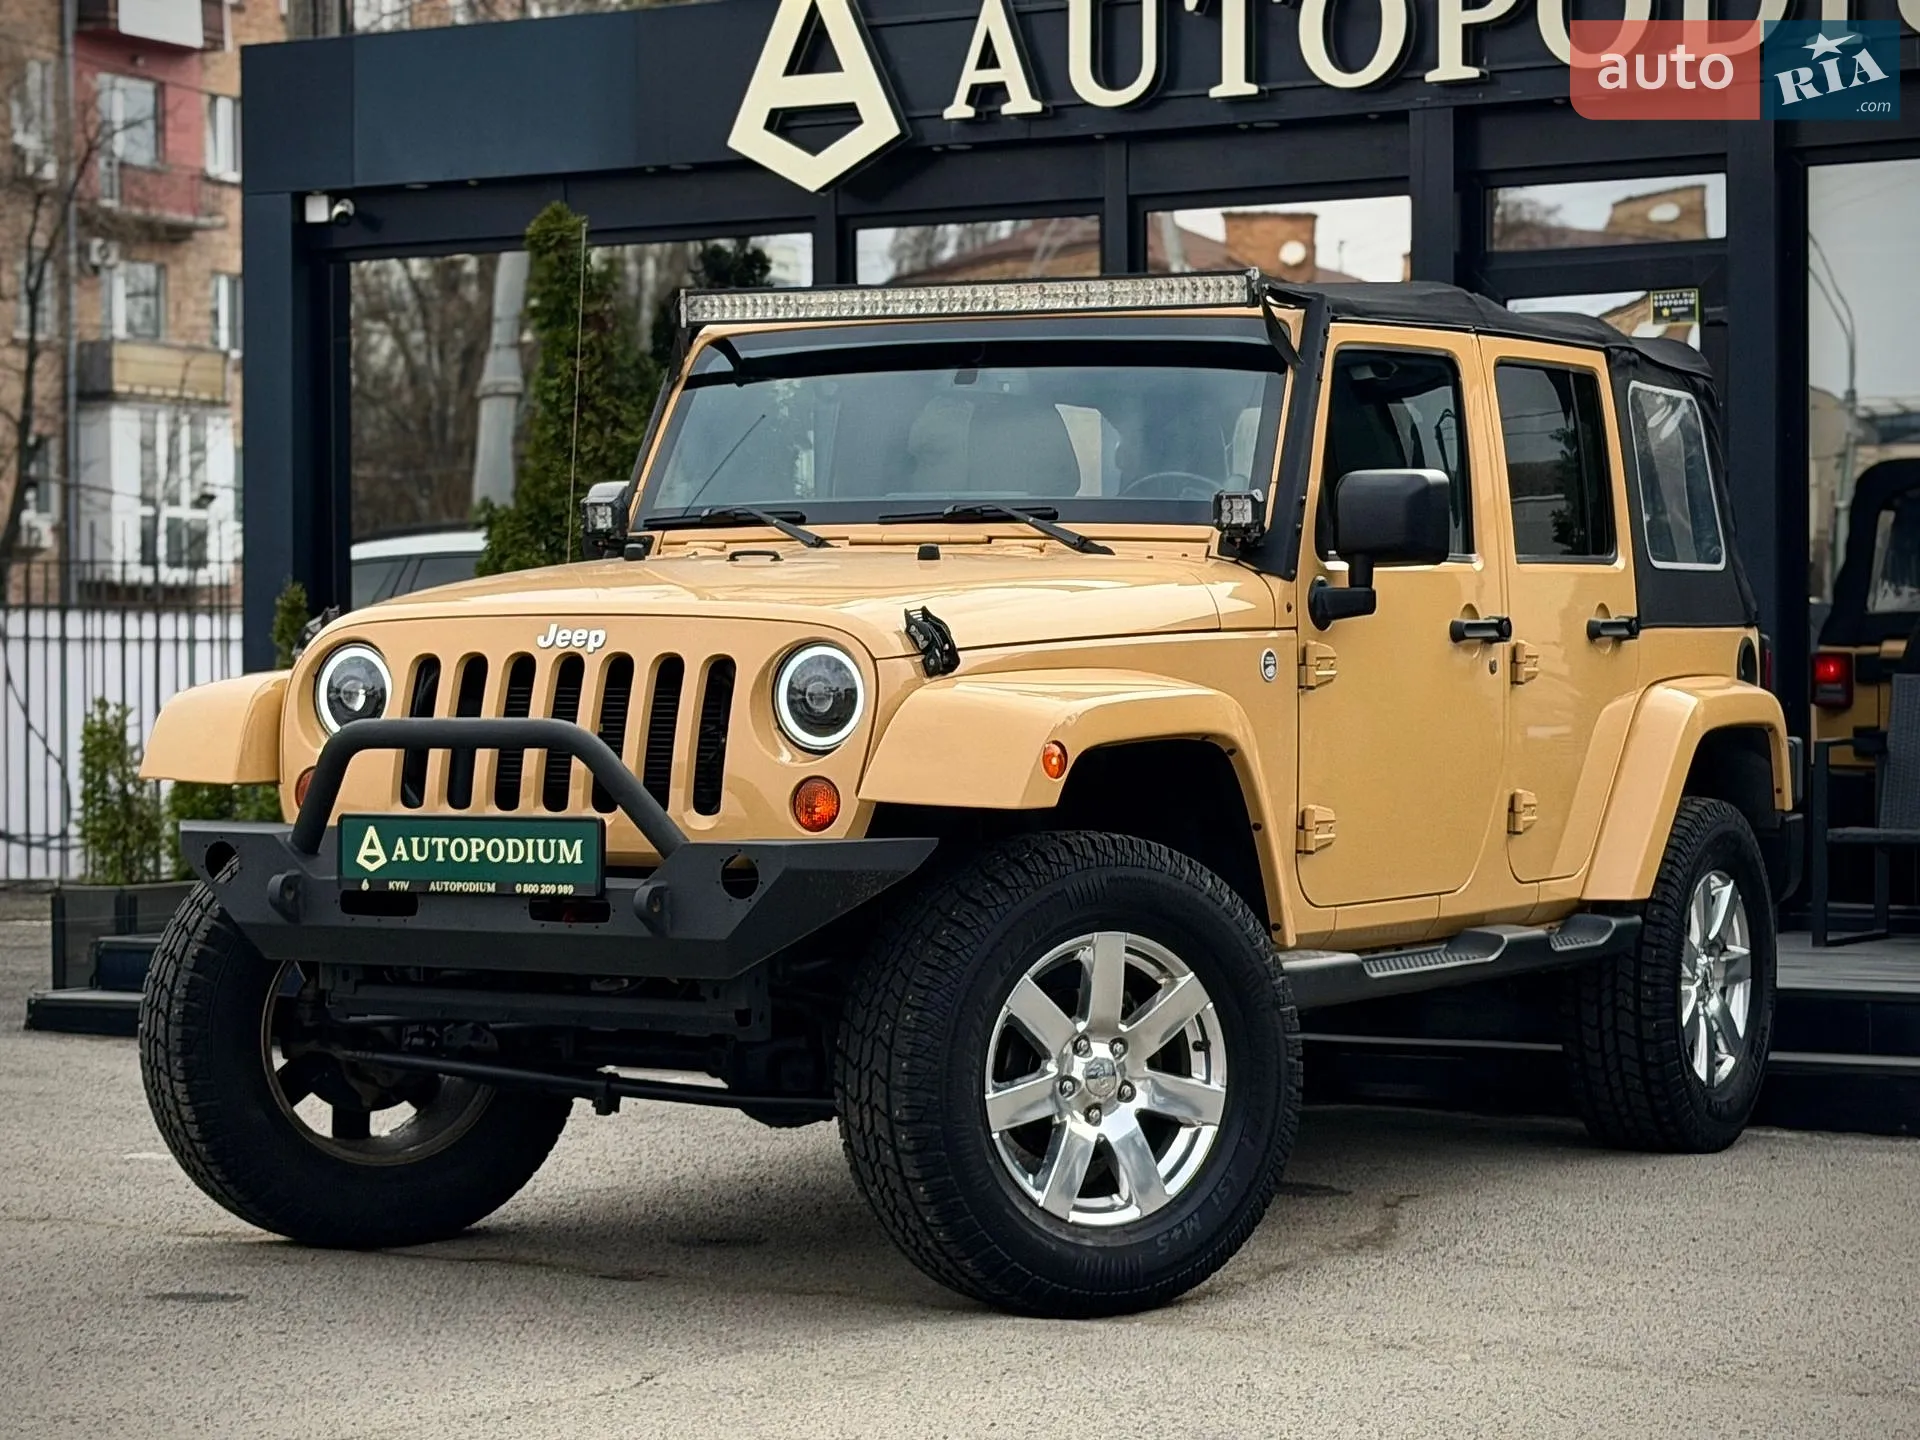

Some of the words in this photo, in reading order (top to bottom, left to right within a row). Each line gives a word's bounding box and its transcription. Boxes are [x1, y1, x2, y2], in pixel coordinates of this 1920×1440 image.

[536, 623, 607, 654] Jeep
[391, 837, 584, 865] AUTOPODIUM
[388, 880, 410, 892] KYIV
[429, 881, 497, 893] AUTOPODIUM
